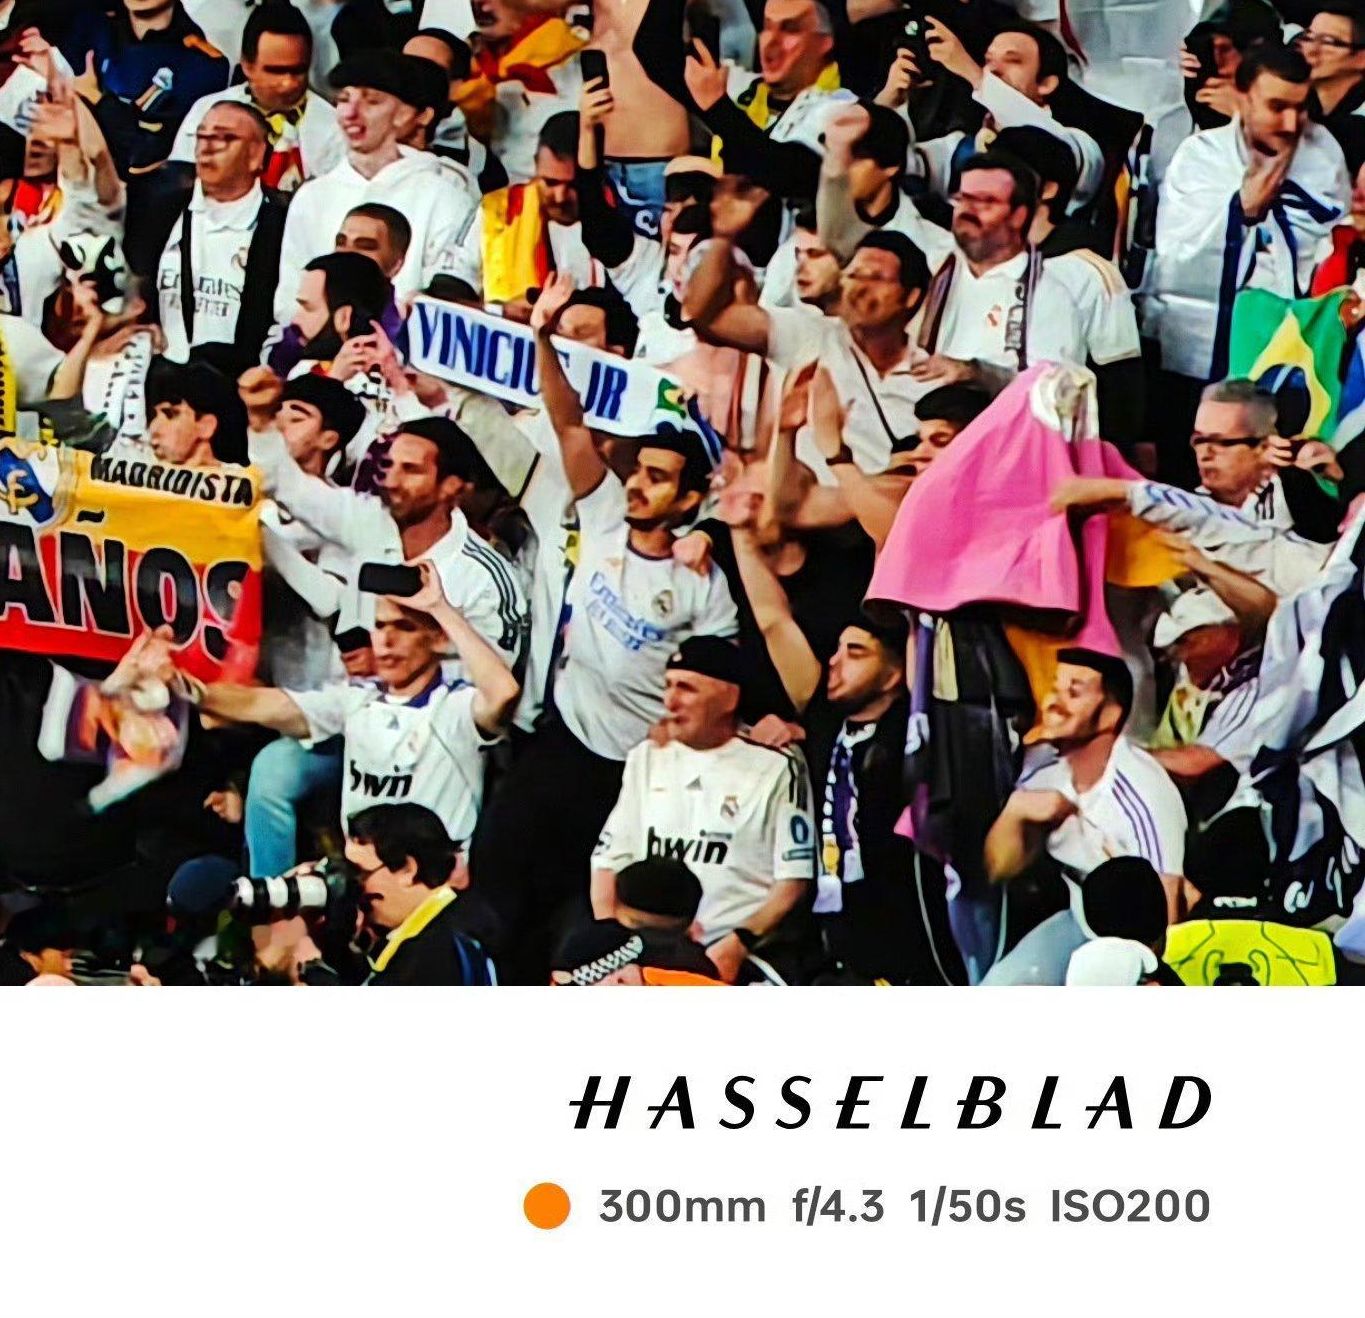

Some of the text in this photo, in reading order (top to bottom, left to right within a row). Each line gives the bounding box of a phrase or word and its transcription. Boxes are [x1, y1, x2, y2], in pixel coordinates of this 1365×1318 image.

[415, 301, 628, 421] VINICIU JR
[90, 451, 253, 507] MADRIDISTA
